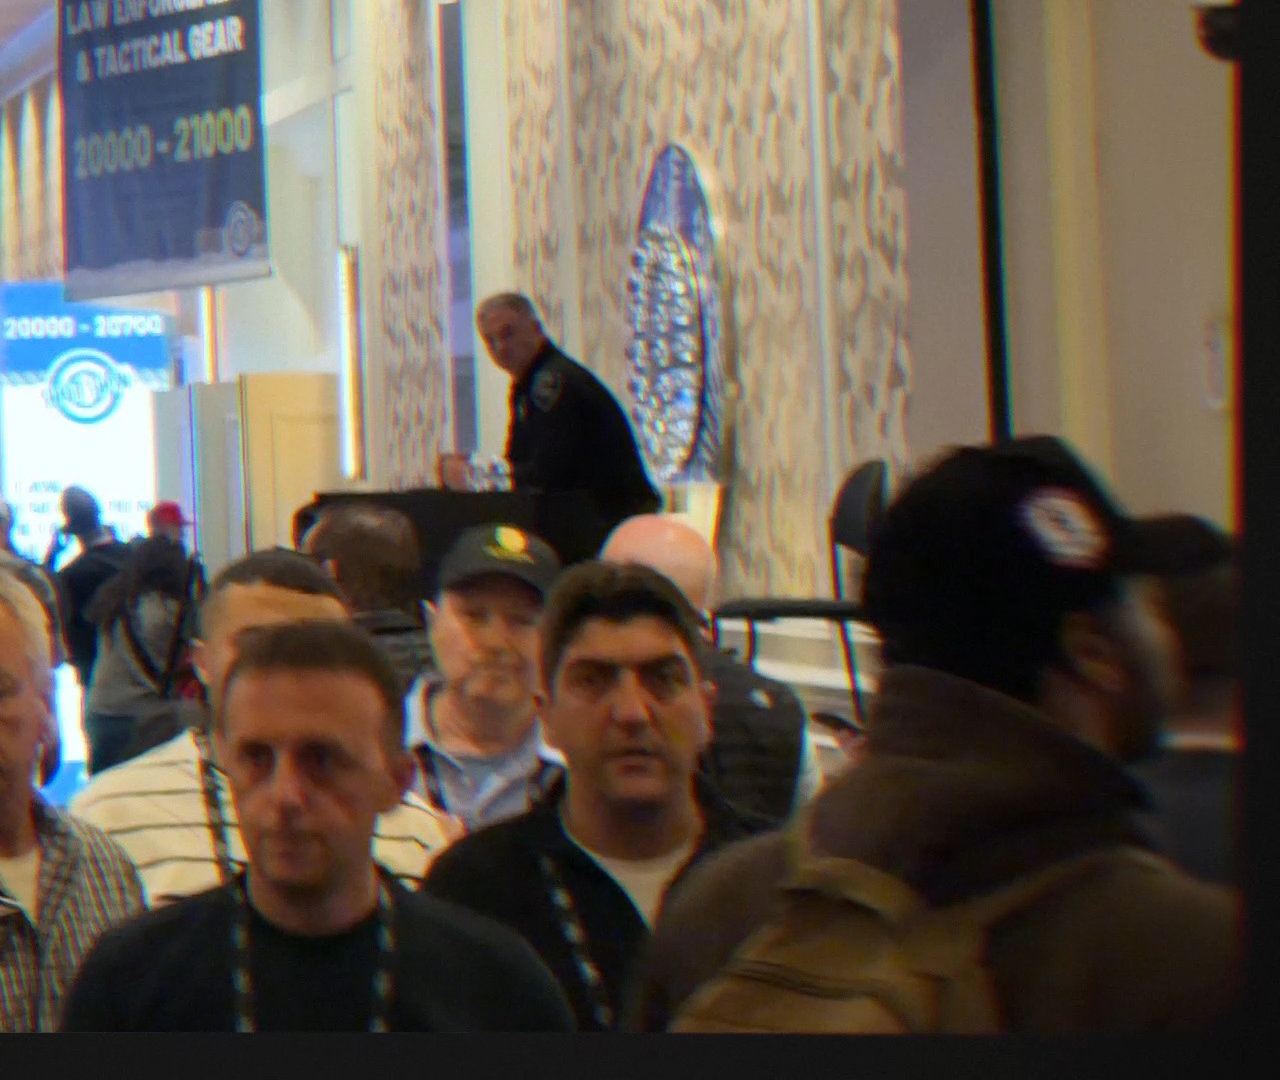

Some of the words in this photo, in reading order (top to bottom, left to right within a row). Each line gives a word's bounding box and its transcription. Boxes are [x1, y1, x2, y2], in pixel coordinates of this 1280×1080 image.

[94, 29, 188, 79] TACTICAL
[188, 15, 246, 60] GEAR
[73, 124, 154, 180] 20000
[173, 103, 255, 163] 21000
